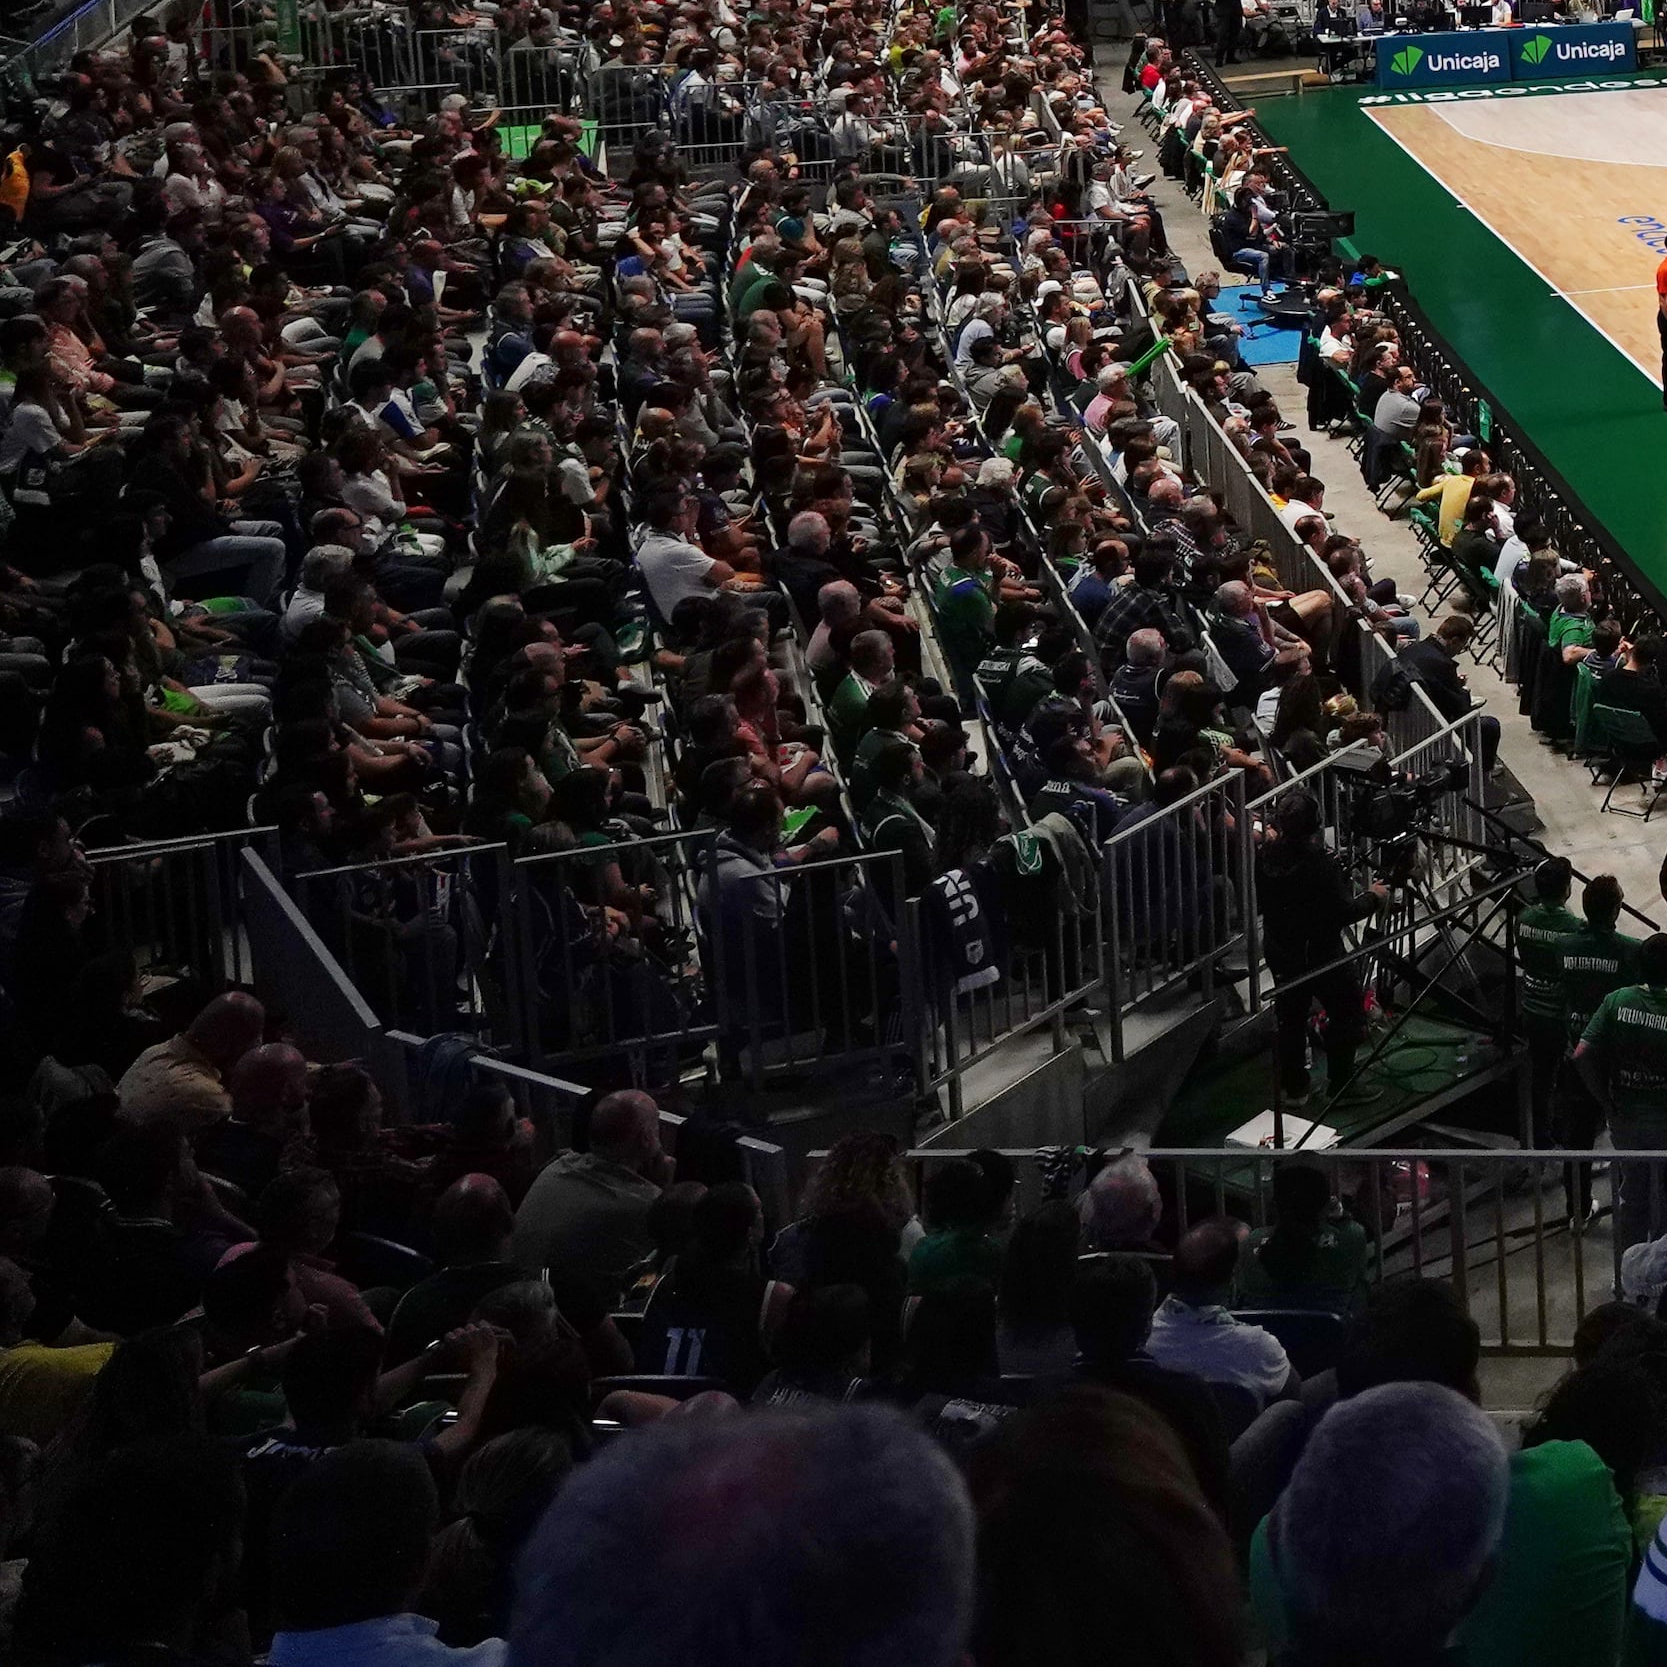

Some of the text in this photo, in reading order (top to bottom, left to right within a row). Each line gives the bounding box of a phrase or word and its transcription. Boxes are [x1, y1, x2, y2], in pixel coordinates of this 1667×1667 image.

[1427, 51, 1500, 73] Unicaja
[1556, 39, 1626, 64] Unicaja
[1563, 956, 1619, 974] VOLUNTARIO
[664, 1328, 706, 1375] 11
